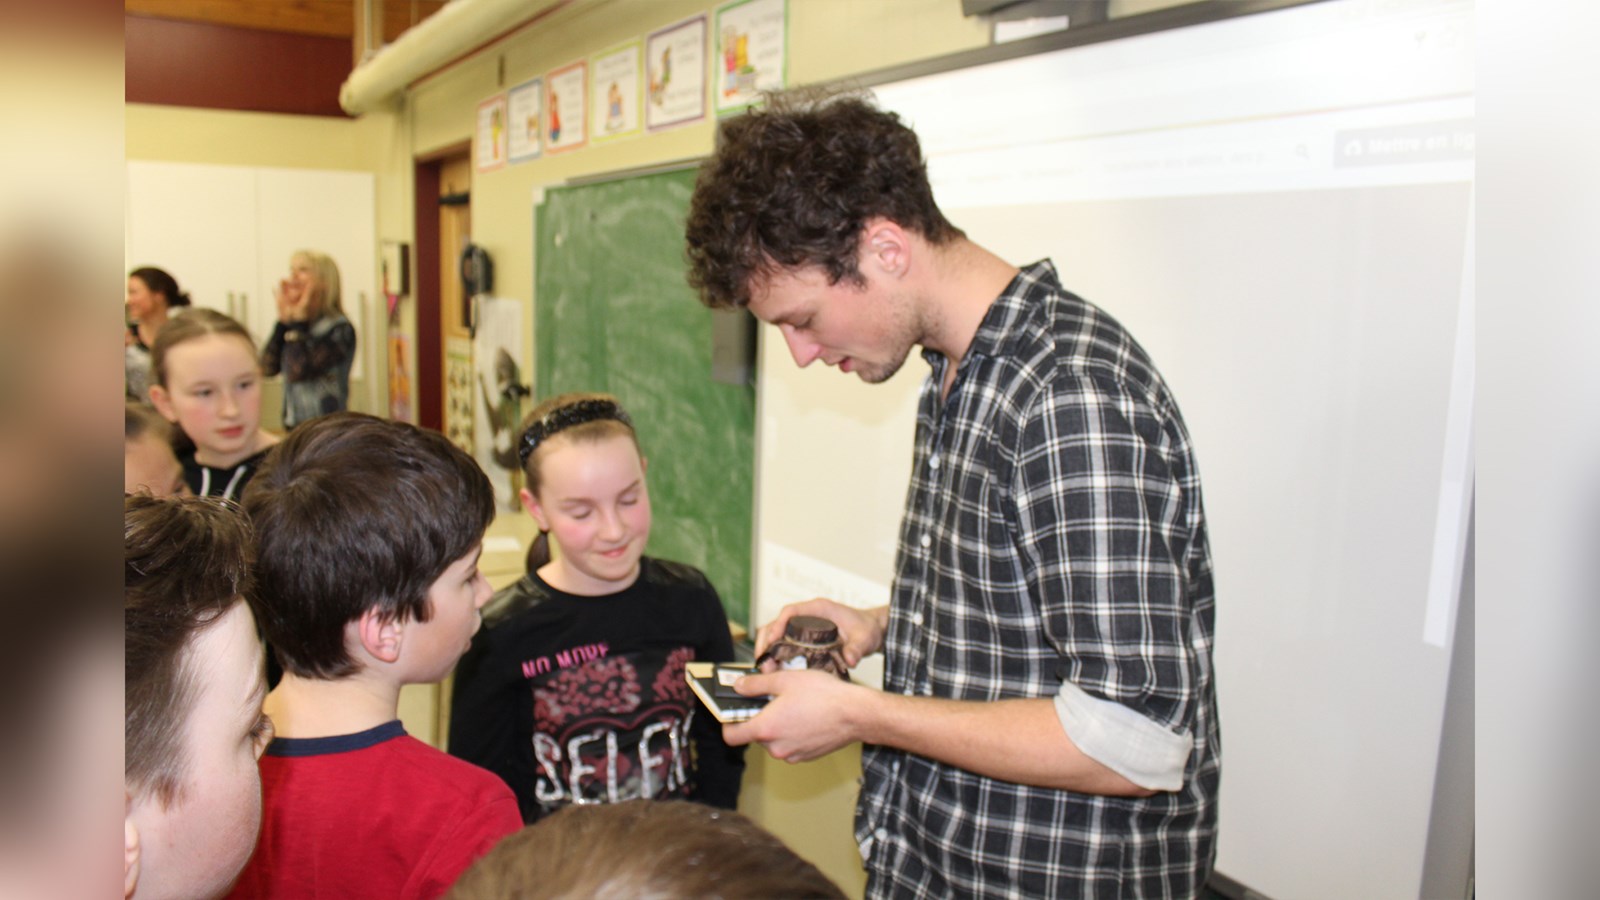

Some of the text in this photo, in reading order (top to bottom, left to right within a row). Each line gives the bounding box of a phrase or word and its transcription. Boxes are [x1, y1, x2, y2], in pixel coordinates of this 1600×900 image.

[1368, 138, 1421, 154] Mettre
[1425, 134, 1447, 150] en
[521, 643, 609, 679] NO MORE
